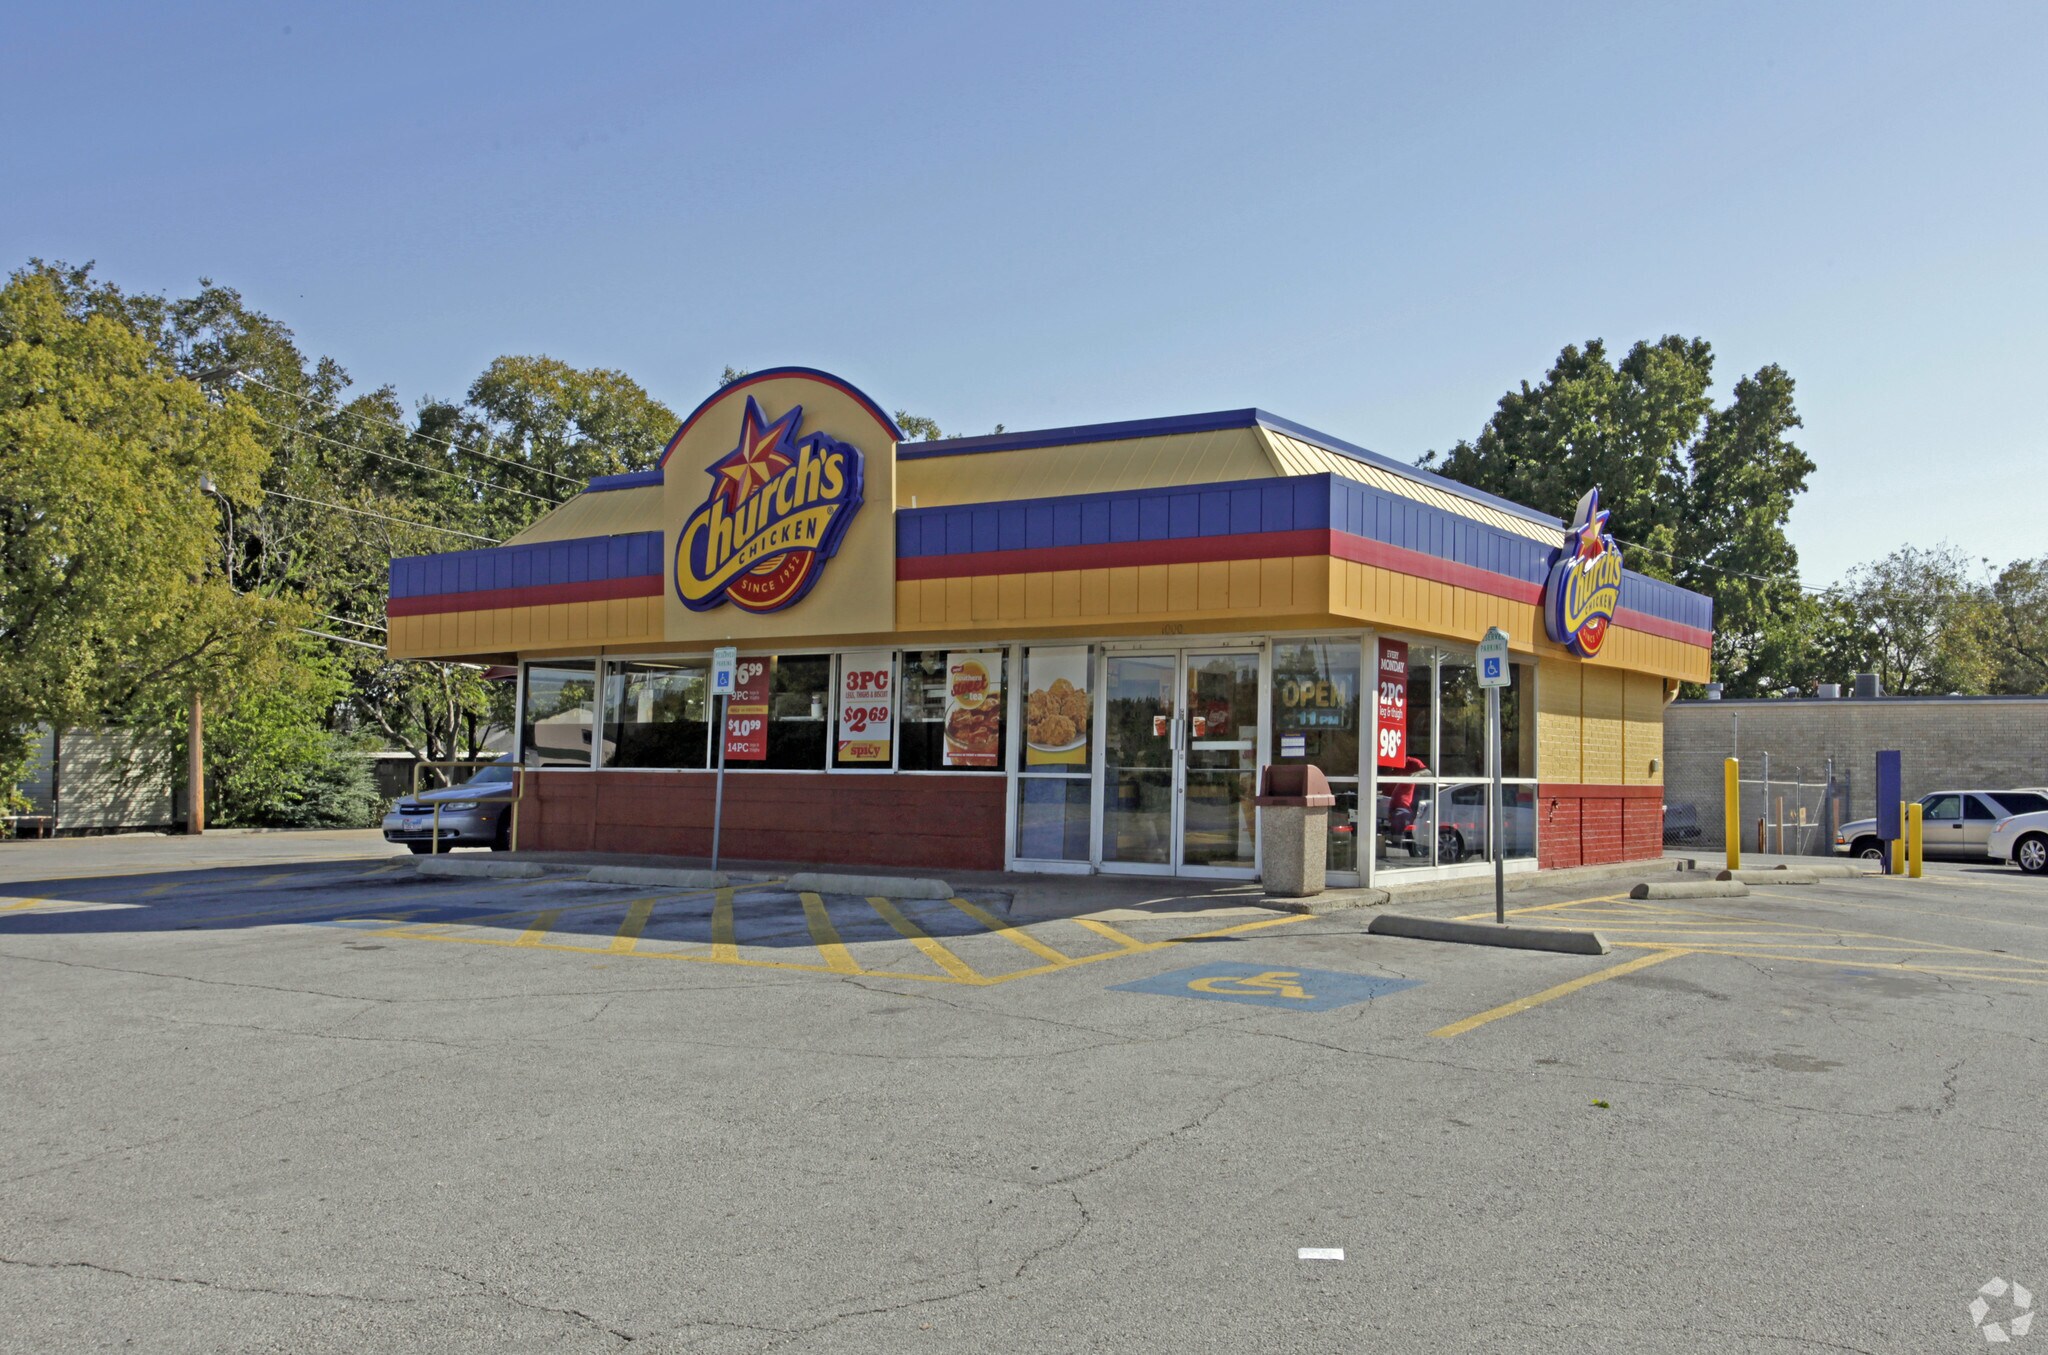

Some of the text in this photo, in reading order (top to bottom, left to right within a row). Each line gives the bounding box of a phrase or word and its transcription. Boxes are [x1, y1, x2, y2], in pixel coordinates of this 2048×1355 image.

[677, 444, 844, 600] Church's
[738, 517, 817, 565] CHICKEN
[741, 556, 800, 593] SINCE 1952
[1565, 542, 1622, 634] Church's
[1585, 594, 1613, 615] CHICKEN
[1380, 658, 1405, 673] MONDAY
[1386, 649, 1399, 660] EVERY
[846, 670, 889, 691] 3PC
[1282, 680, 1346, 708] OPEN
[969, 692, 983, 701] tea
[1380, 681, 1404, 708] 2PC
[727, 742, 749, 752] 14PC
[1379, 728, 1402, 759] 98¢
